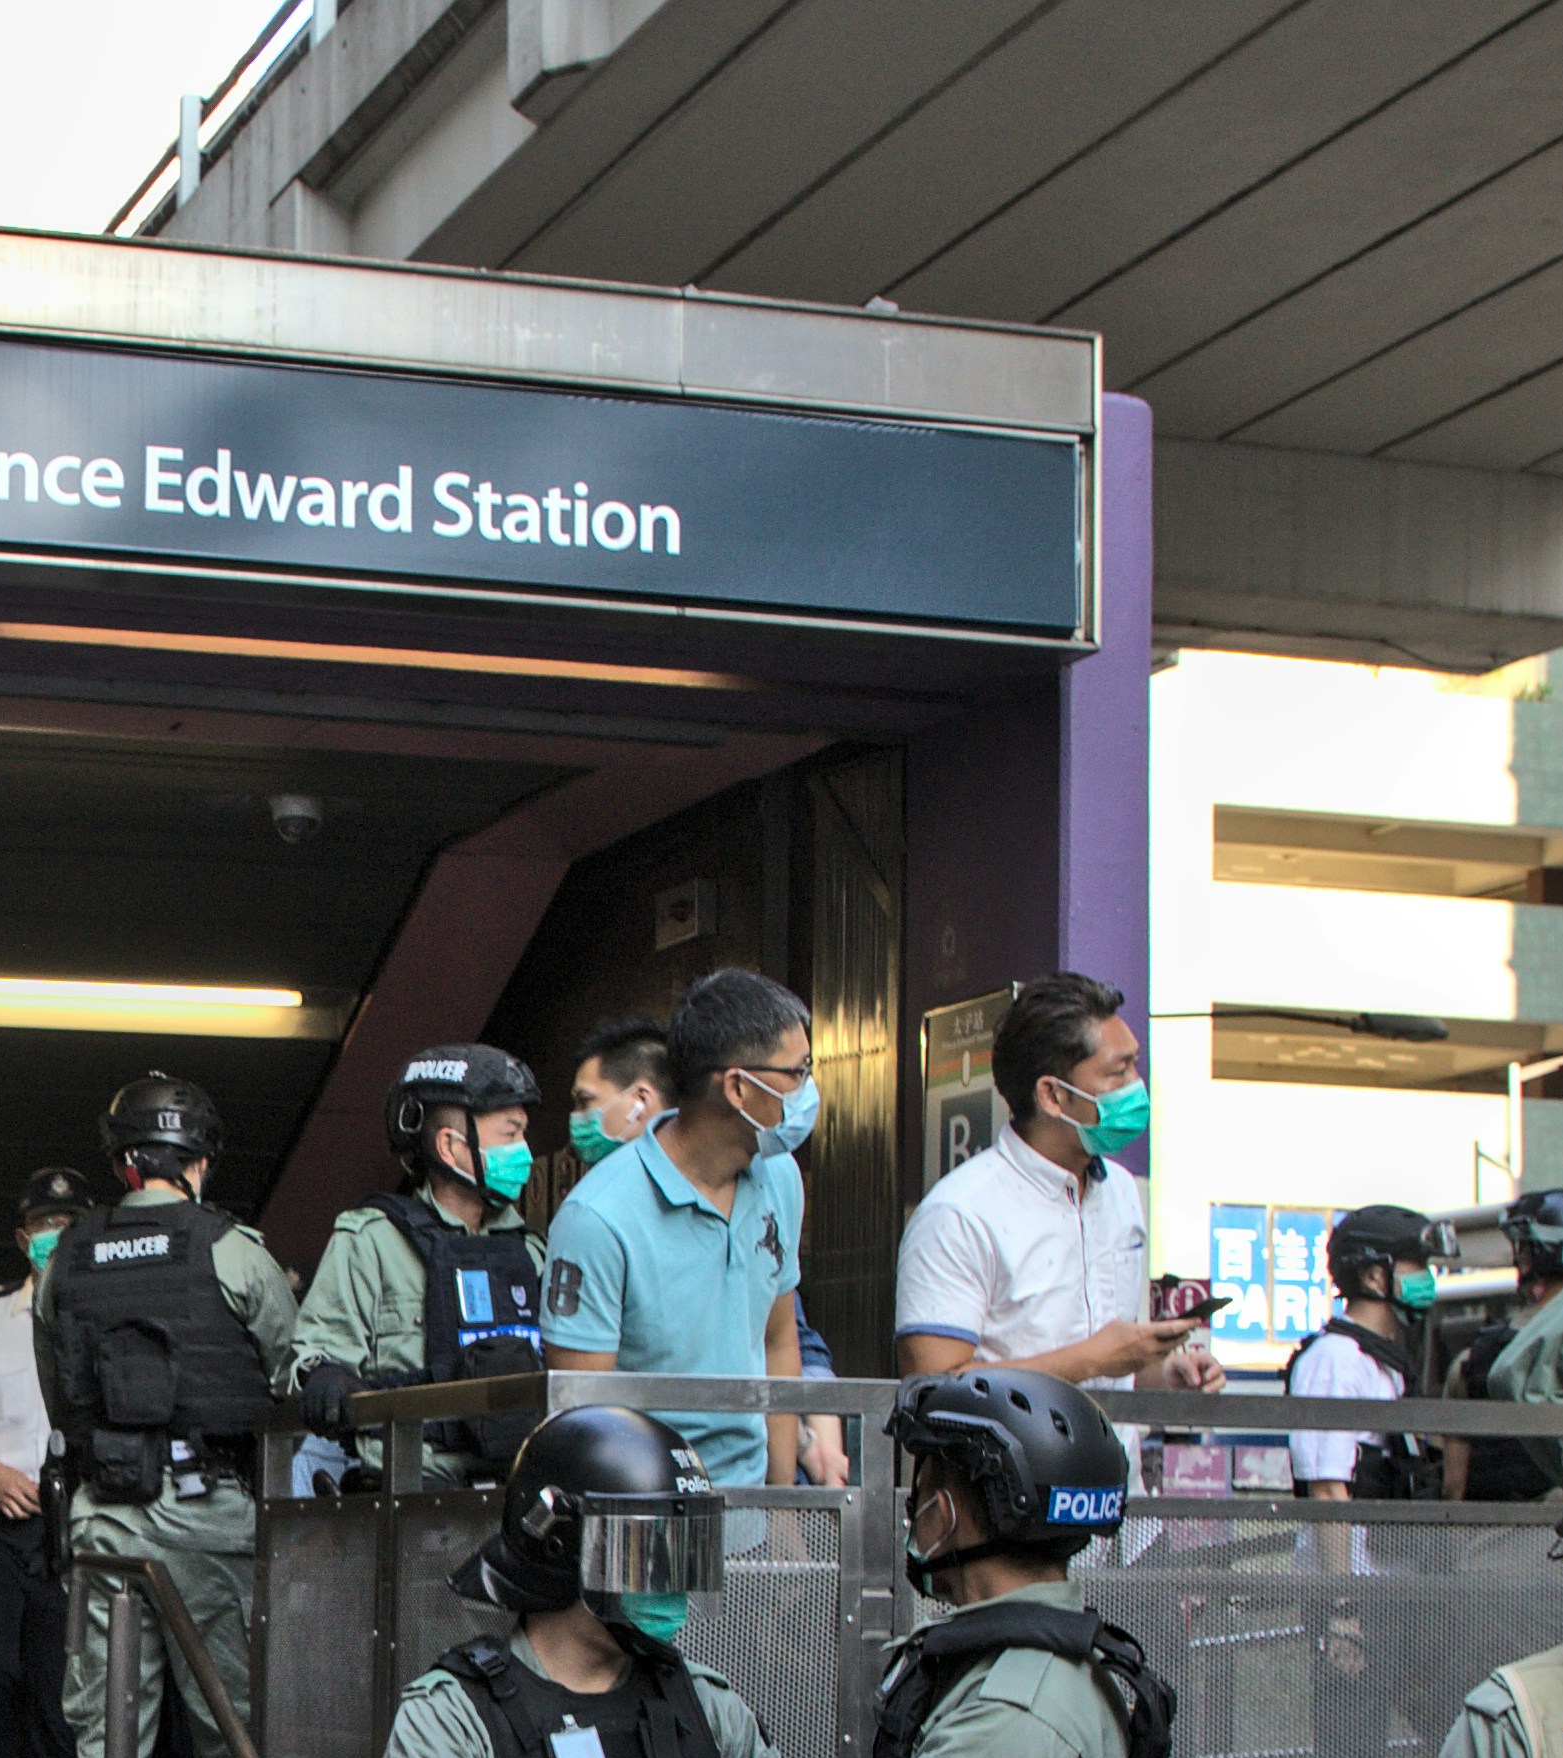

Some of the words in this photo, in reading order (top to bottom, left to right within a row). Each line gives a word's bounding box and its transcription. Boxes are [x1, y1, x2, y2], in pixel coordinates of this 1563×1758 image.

[145, 445, 413, 534] Edward
[432, 471, 681, 555] Station
[1053, 1490, 1124, 1520] POLICE
